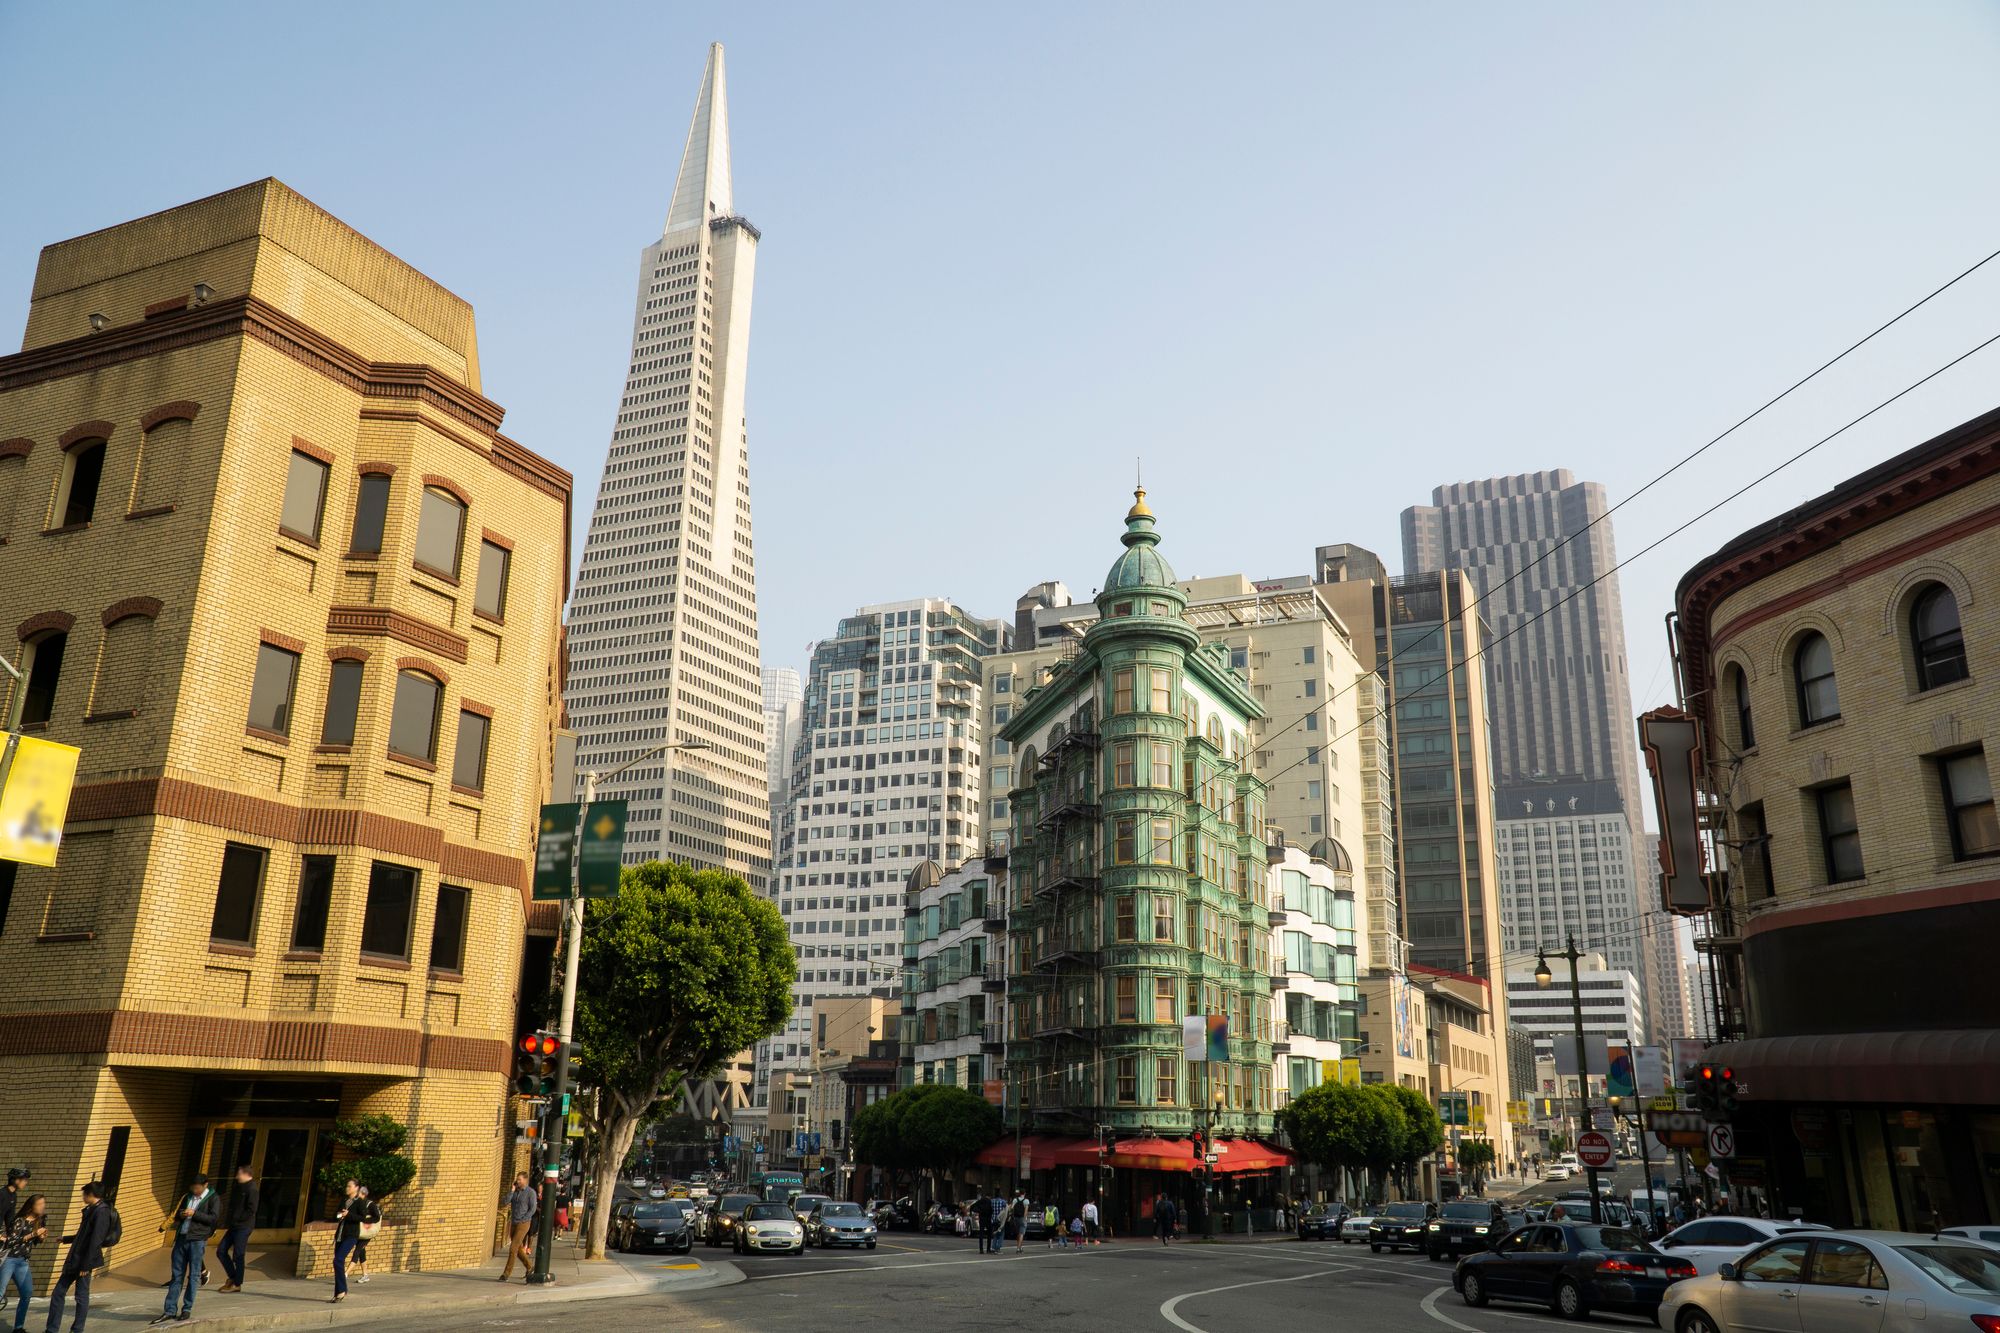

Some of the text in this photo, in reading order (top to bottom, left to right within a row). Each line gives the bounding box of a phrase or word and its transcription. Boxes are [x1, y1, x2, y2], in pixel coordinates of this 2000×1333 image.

[1581, 1137, 1605, 1145] DO NOT
[1584, 1153, 1605, 1161] ENTER
